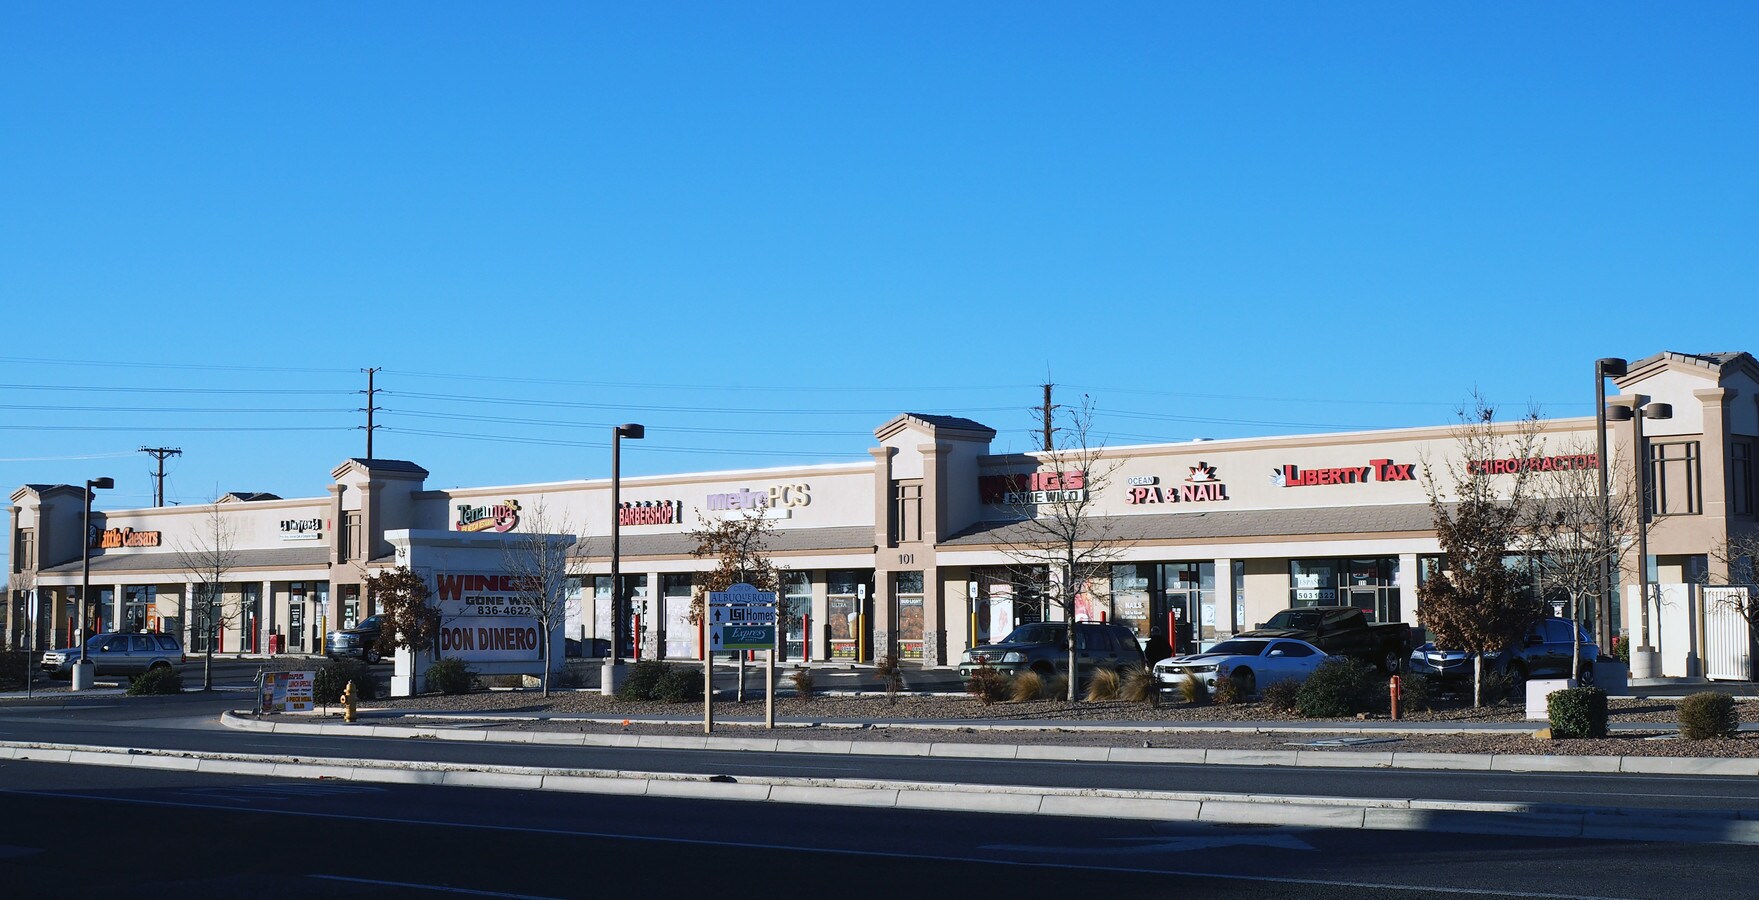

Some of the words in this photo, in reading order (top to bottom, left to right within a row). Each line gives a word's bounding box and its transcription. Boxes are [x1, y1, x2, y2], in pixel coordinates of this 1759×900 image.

[1127, 476, 1154, 486] OCEAN
[1125, 486, 1161, 505] SPA
[1165, 487, 1176, 503] &
[1181, 484, 1225, 502] NAIL
[457, 505, 514, 525] Tenampa
[619, 504, 673, 526] BARBERSHOP
[122, 527, 159, 547] Caesars
[898, 553, 915, 565] 101
[465, 596, 505, 606] GONE
[711, 593, 774, 603] ALBUQUERQUE
[477, 606, 531, 616] 836-4622
[730, 608, 745, 621] LGI
[746, 608, 774, 621] Homes
[441, 627, 474, 651] DON
[478, 627, 538, 651] DINERO
[732, 627, 766, 641] Express
